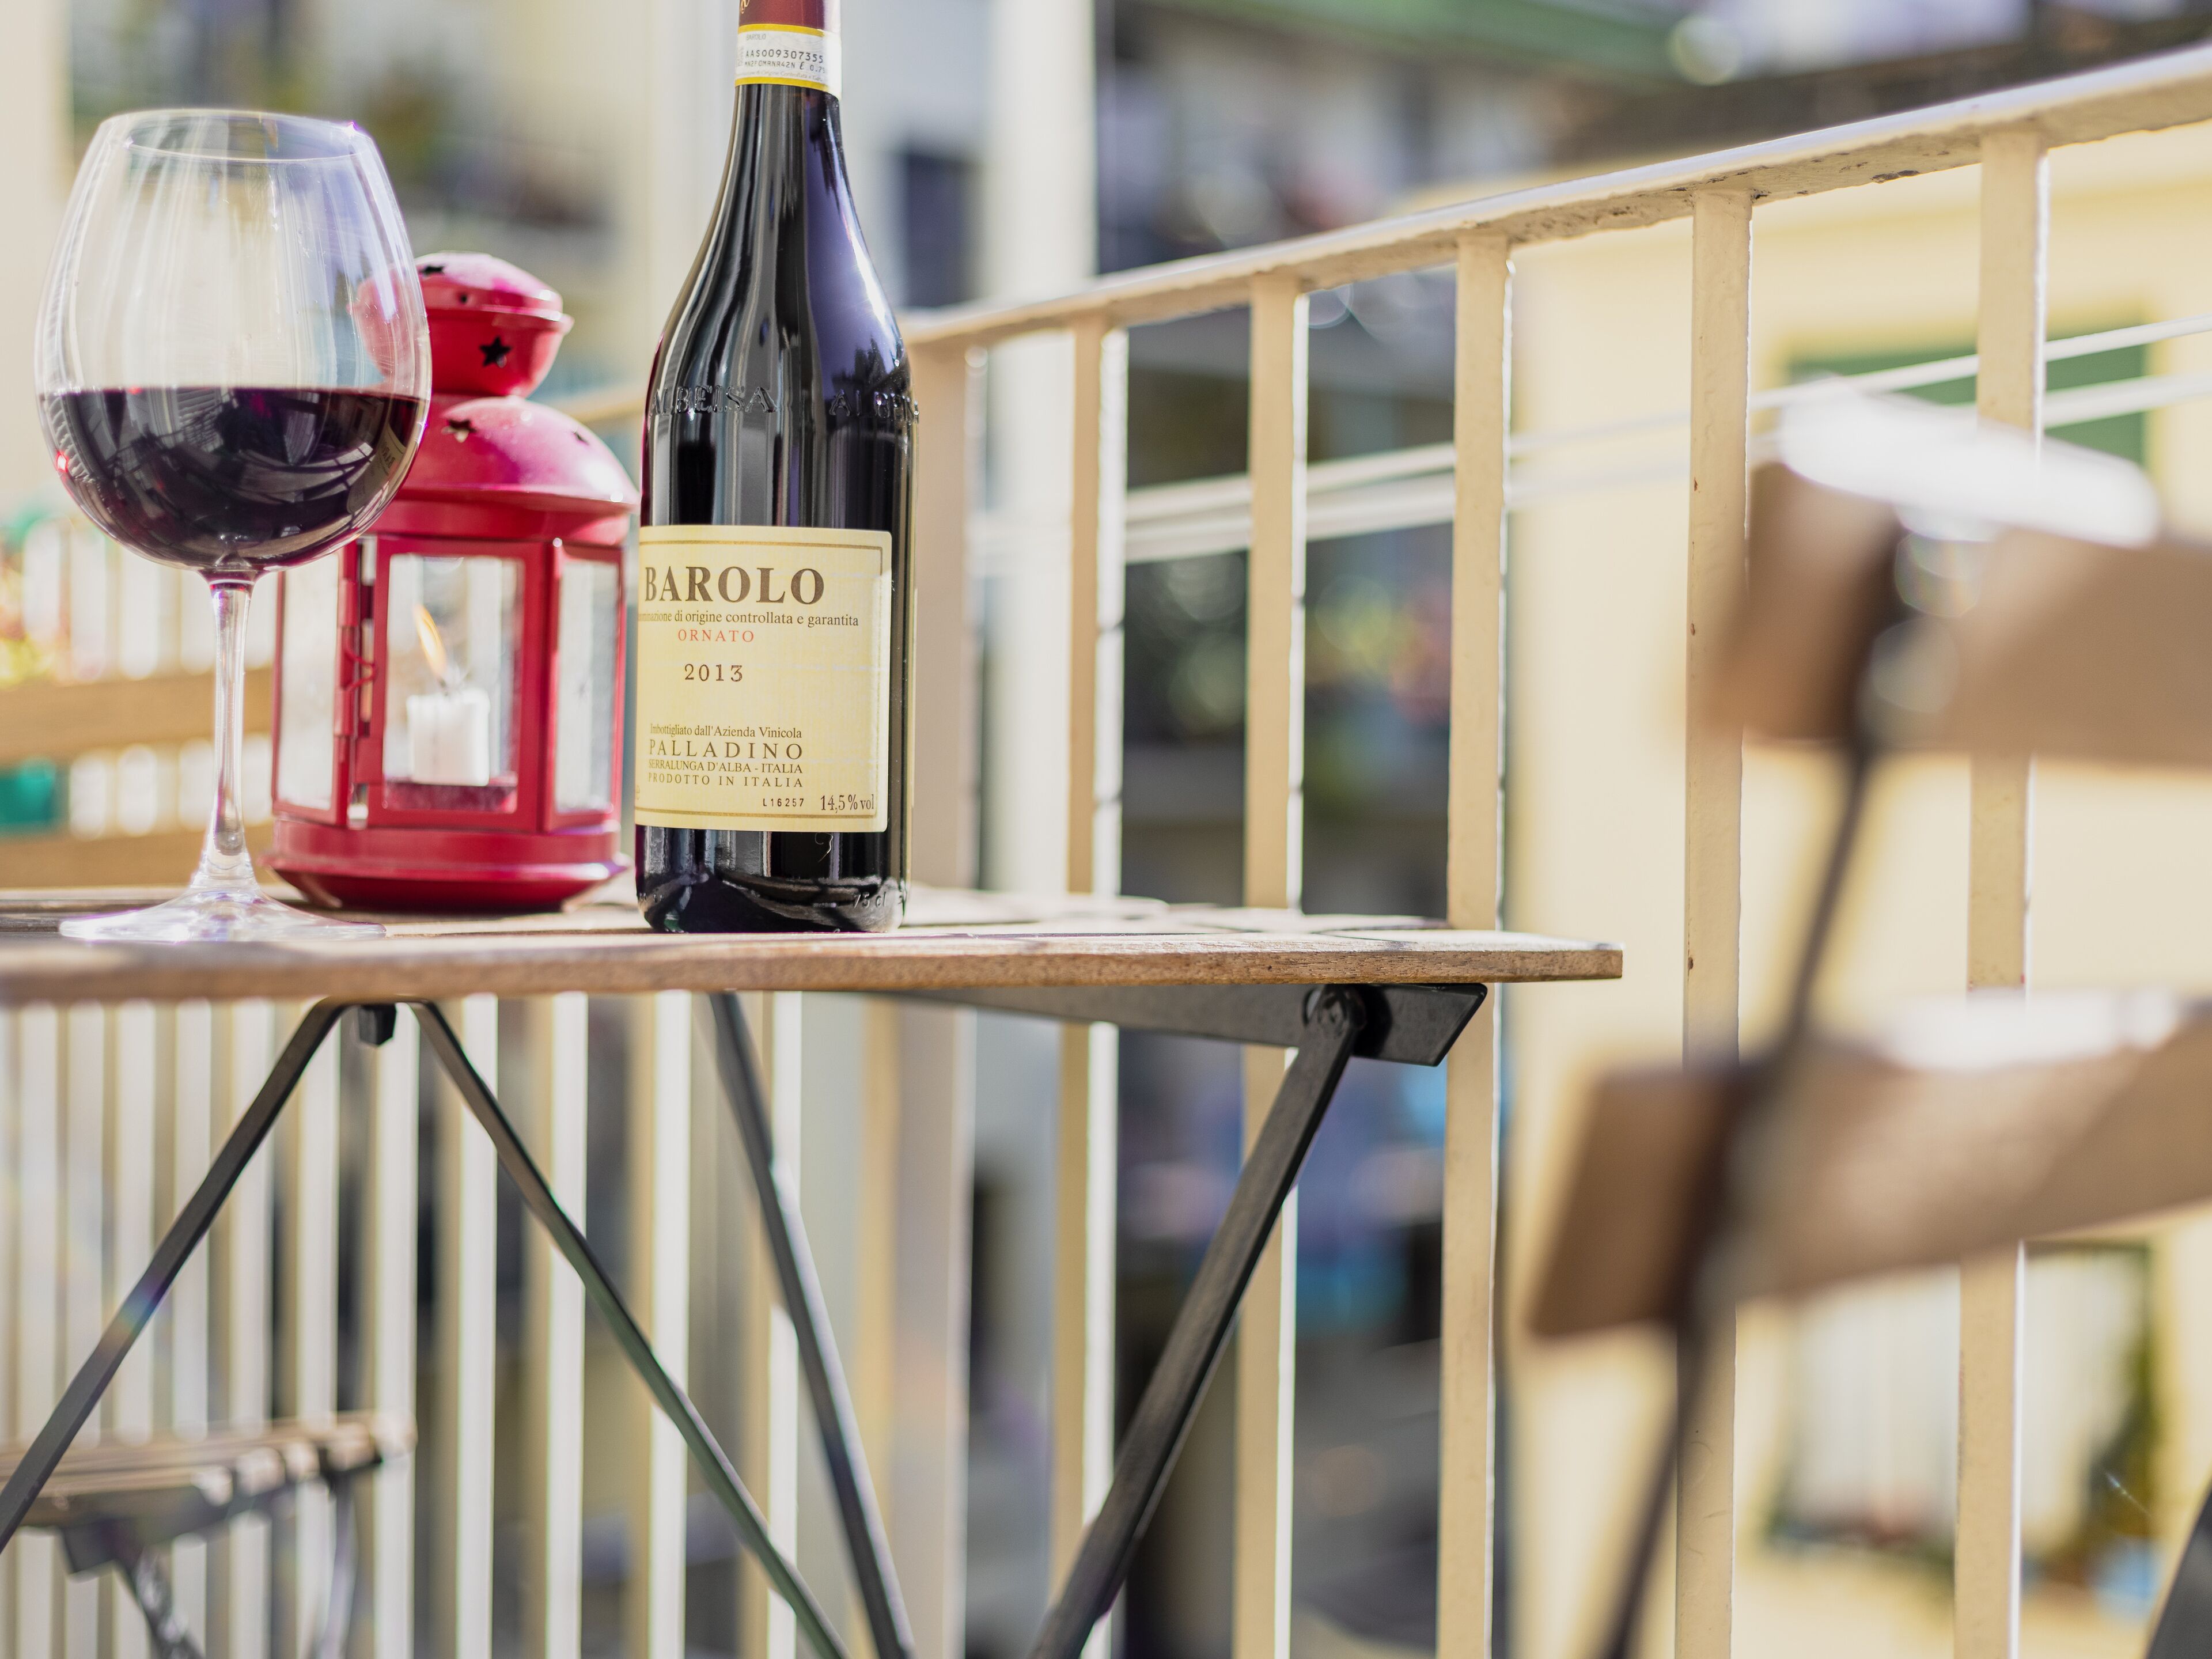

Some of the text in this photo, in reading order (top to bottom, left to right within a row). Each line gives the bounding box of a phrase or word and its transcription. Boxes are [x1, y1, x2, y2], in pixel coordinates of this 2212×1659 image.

[645, 566, 824, 605] BAROLO
[675, 610, 683, 622] di
[685, 610, 722, 626] origine
[726, 612, 793, 624] controllata
[797, 615, 804, 624] e
[808, 614, 859, 628] garantita
[678, 629, 755, 642] ORNATO
[684, 664, 744, 682] 2013
[650, 724, 802, 738] Imbottigliato dall'Azienda Vinicola
[649, 738, 802, 760] PALLADINO
[649, 759, 704, 771] SERRALUNGA
[707, 762, 751, 772] D'ALBA
[762, 763, 803, 774] ITALIA
[648, 772, 803, 787] PRODOTTO IN ITALIA
[763, 798, 804, 807] L16257
[860, 794, 874, 810] vol
